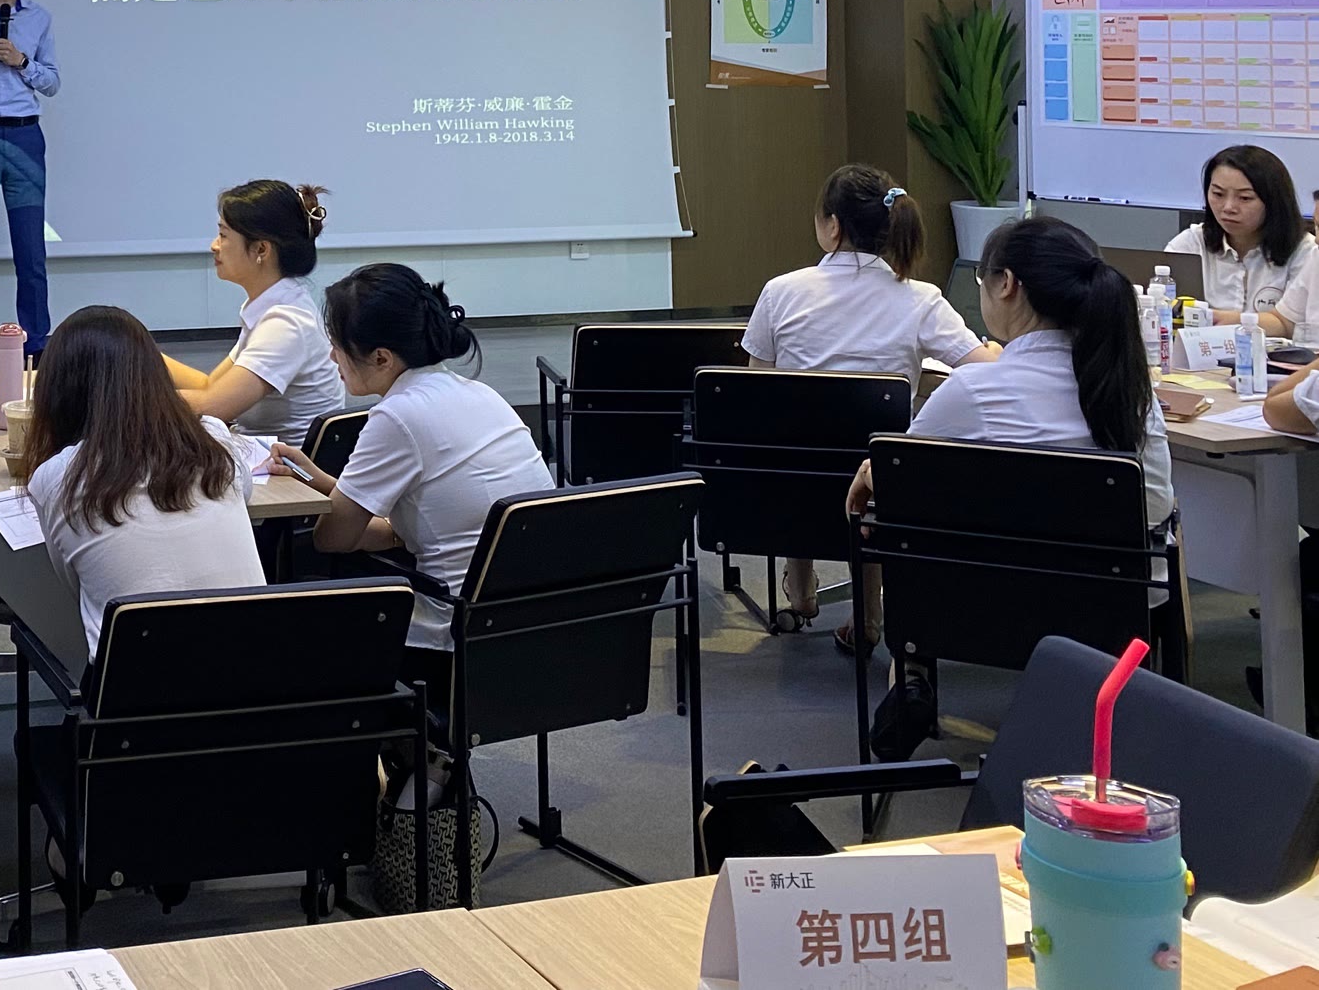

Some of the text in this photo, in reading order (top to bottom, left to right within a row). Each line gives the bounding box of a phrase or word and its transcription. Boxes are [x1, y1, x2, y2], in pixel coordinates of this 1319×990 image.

[413, 95, 574, 115] 斯蒂芬·威廉·霍金
[366, 117, 575, 136] Stephen William Hawking
[434, 131, 576, 145] 1942.1.8-2018.3.14
[770, 872, 816, 890] 新大正
[796, 906, 952, 968] 第四组
